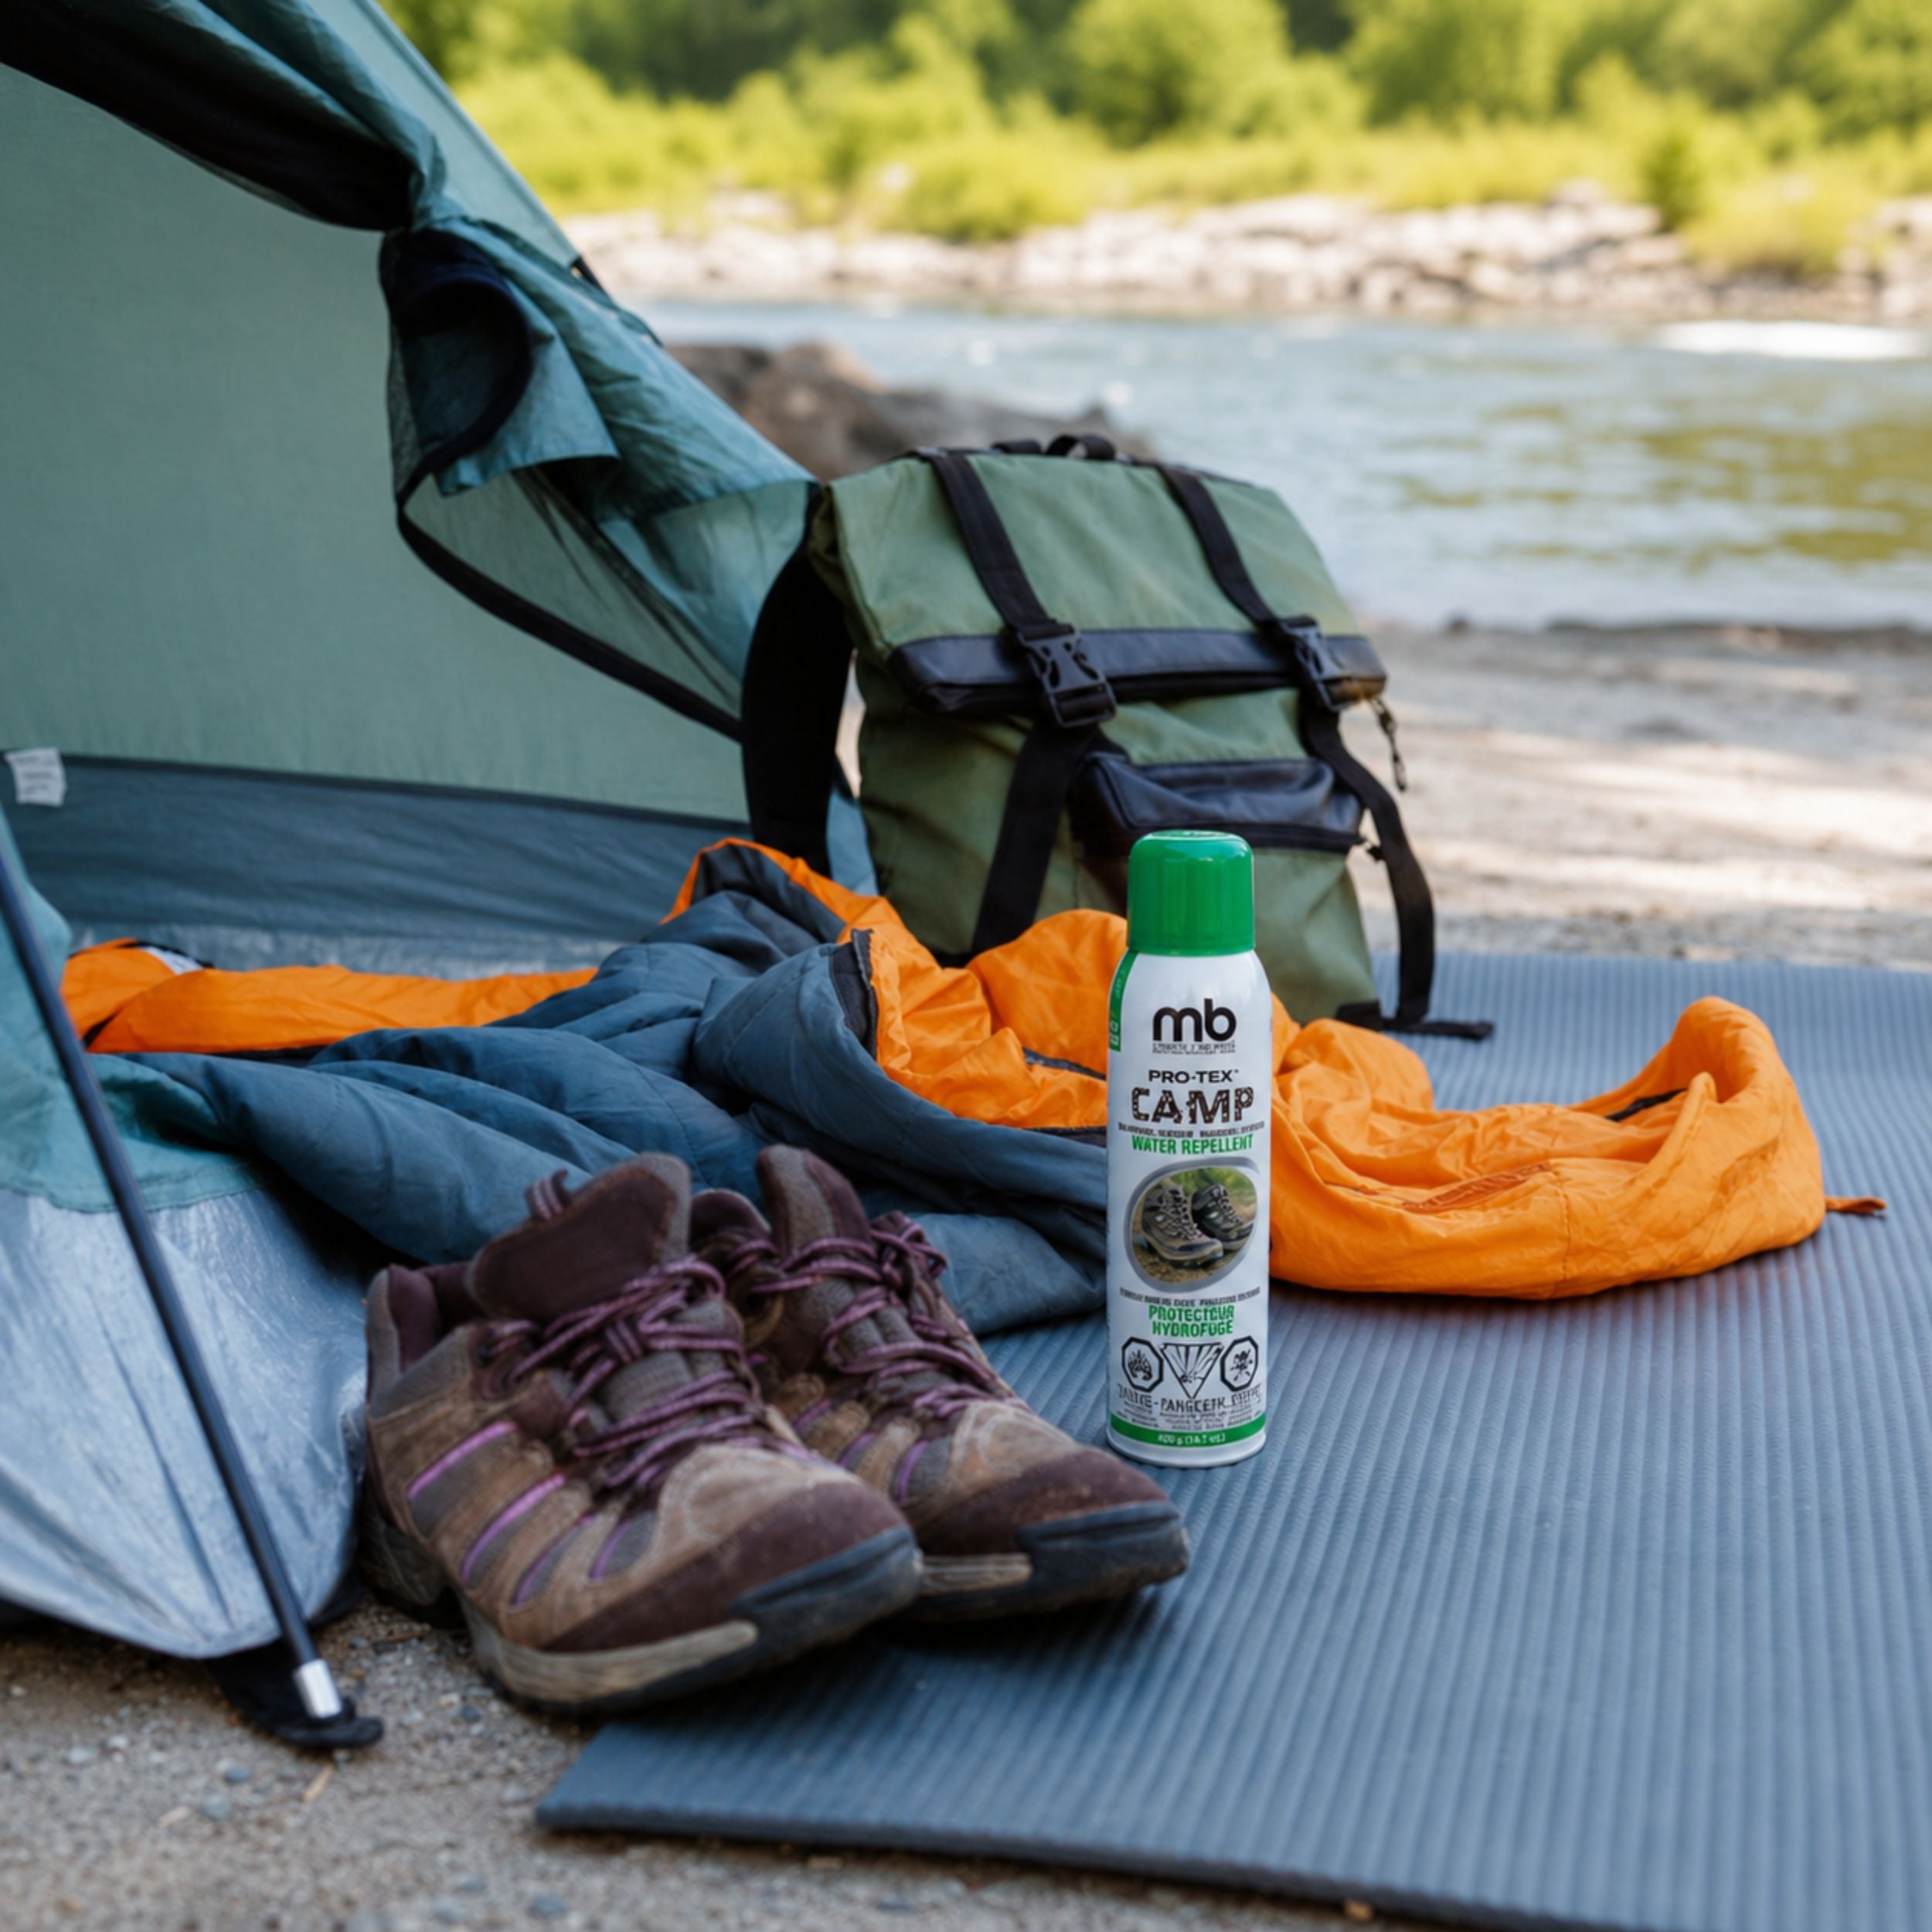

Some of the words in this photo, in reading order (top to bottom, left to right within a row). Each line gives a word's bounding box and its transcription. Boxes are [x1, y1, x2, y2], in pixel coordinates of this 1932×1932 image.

[1152, 998, 1236, 1042] mb
[1131, 1086, 1254, 1124] CAMP
[1131, 1134, 1177, 1155] WATER
[1181, 1134, 1253, 1155] REPELLENT
[1152, 1320, 1233, 1338] HYDROFUGE
